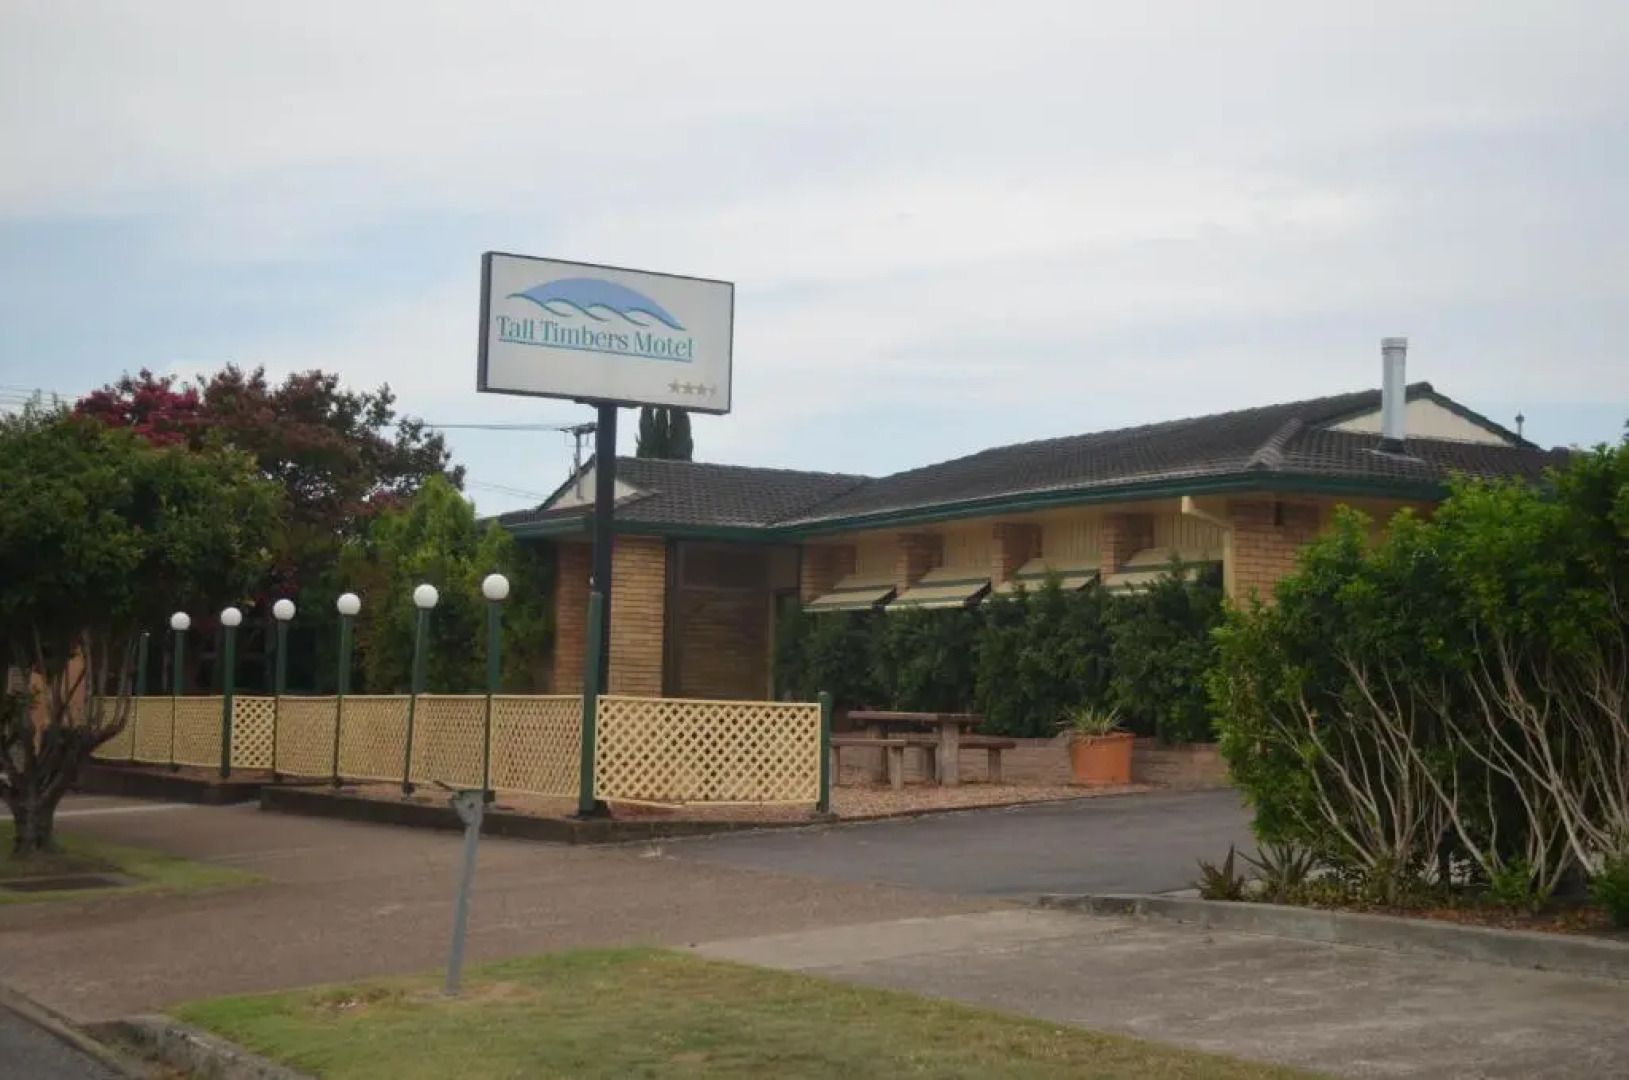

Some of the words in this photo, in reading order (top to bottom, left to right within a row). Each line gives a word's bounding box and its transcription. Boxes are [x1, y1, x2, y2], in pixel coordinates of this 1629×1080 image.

[496, 315, 535, 341] Tall
[538, 318, 629, 351] Timbers
[635, 331, 693, 358] Motel
